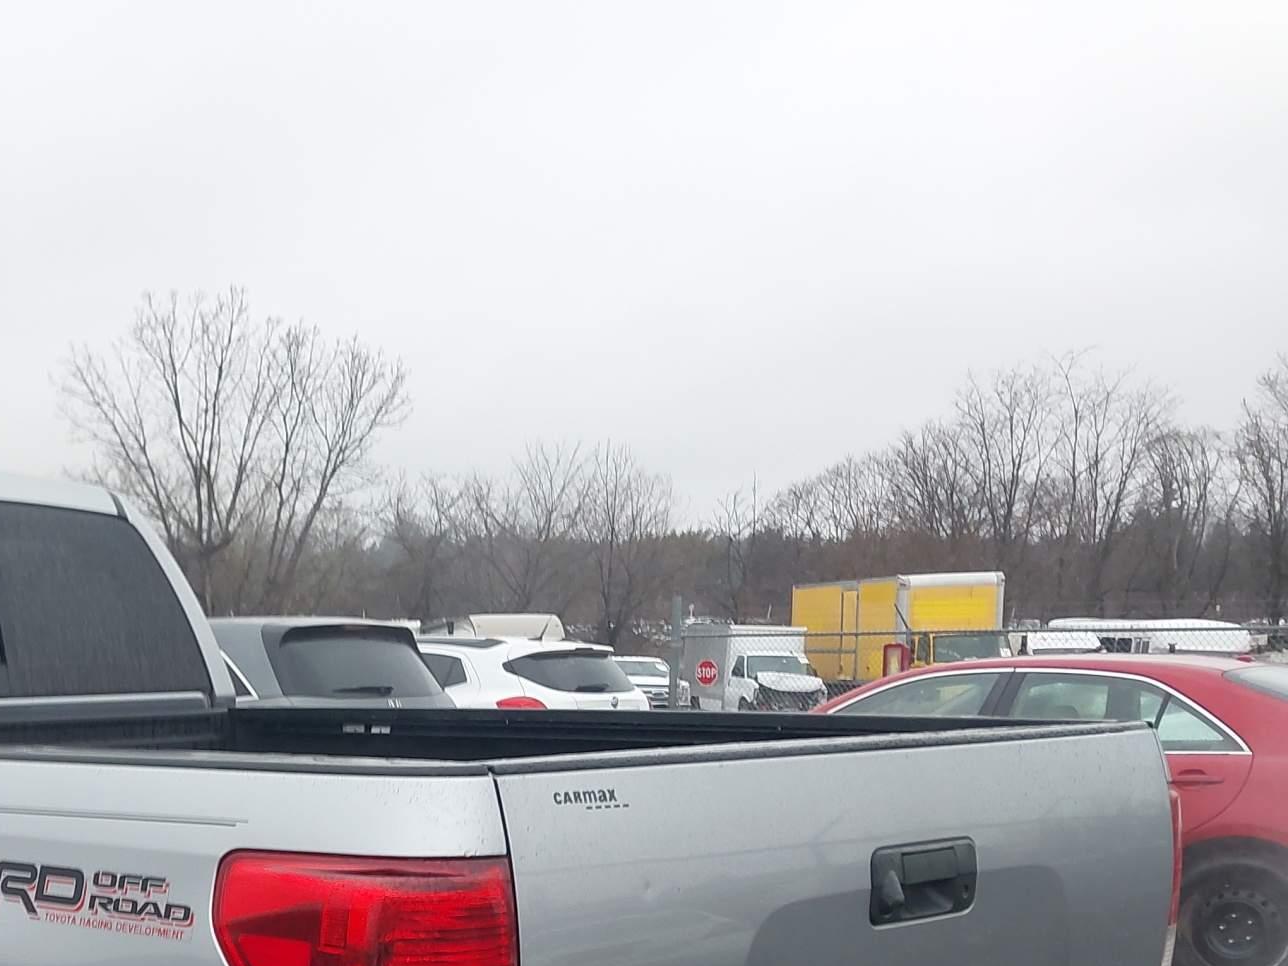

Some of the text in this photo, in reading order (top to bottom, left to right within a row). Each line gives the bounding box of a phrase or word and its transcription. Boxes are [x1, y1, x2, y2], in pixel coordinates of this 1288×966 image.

[697, 667, 717, 679] STOP
[92, 870, 170, 897] OFF
[87, 894, 194, 928] ROAD
[43, 912, 185, 941] TOYOTA RACING DEVELOPMENT
